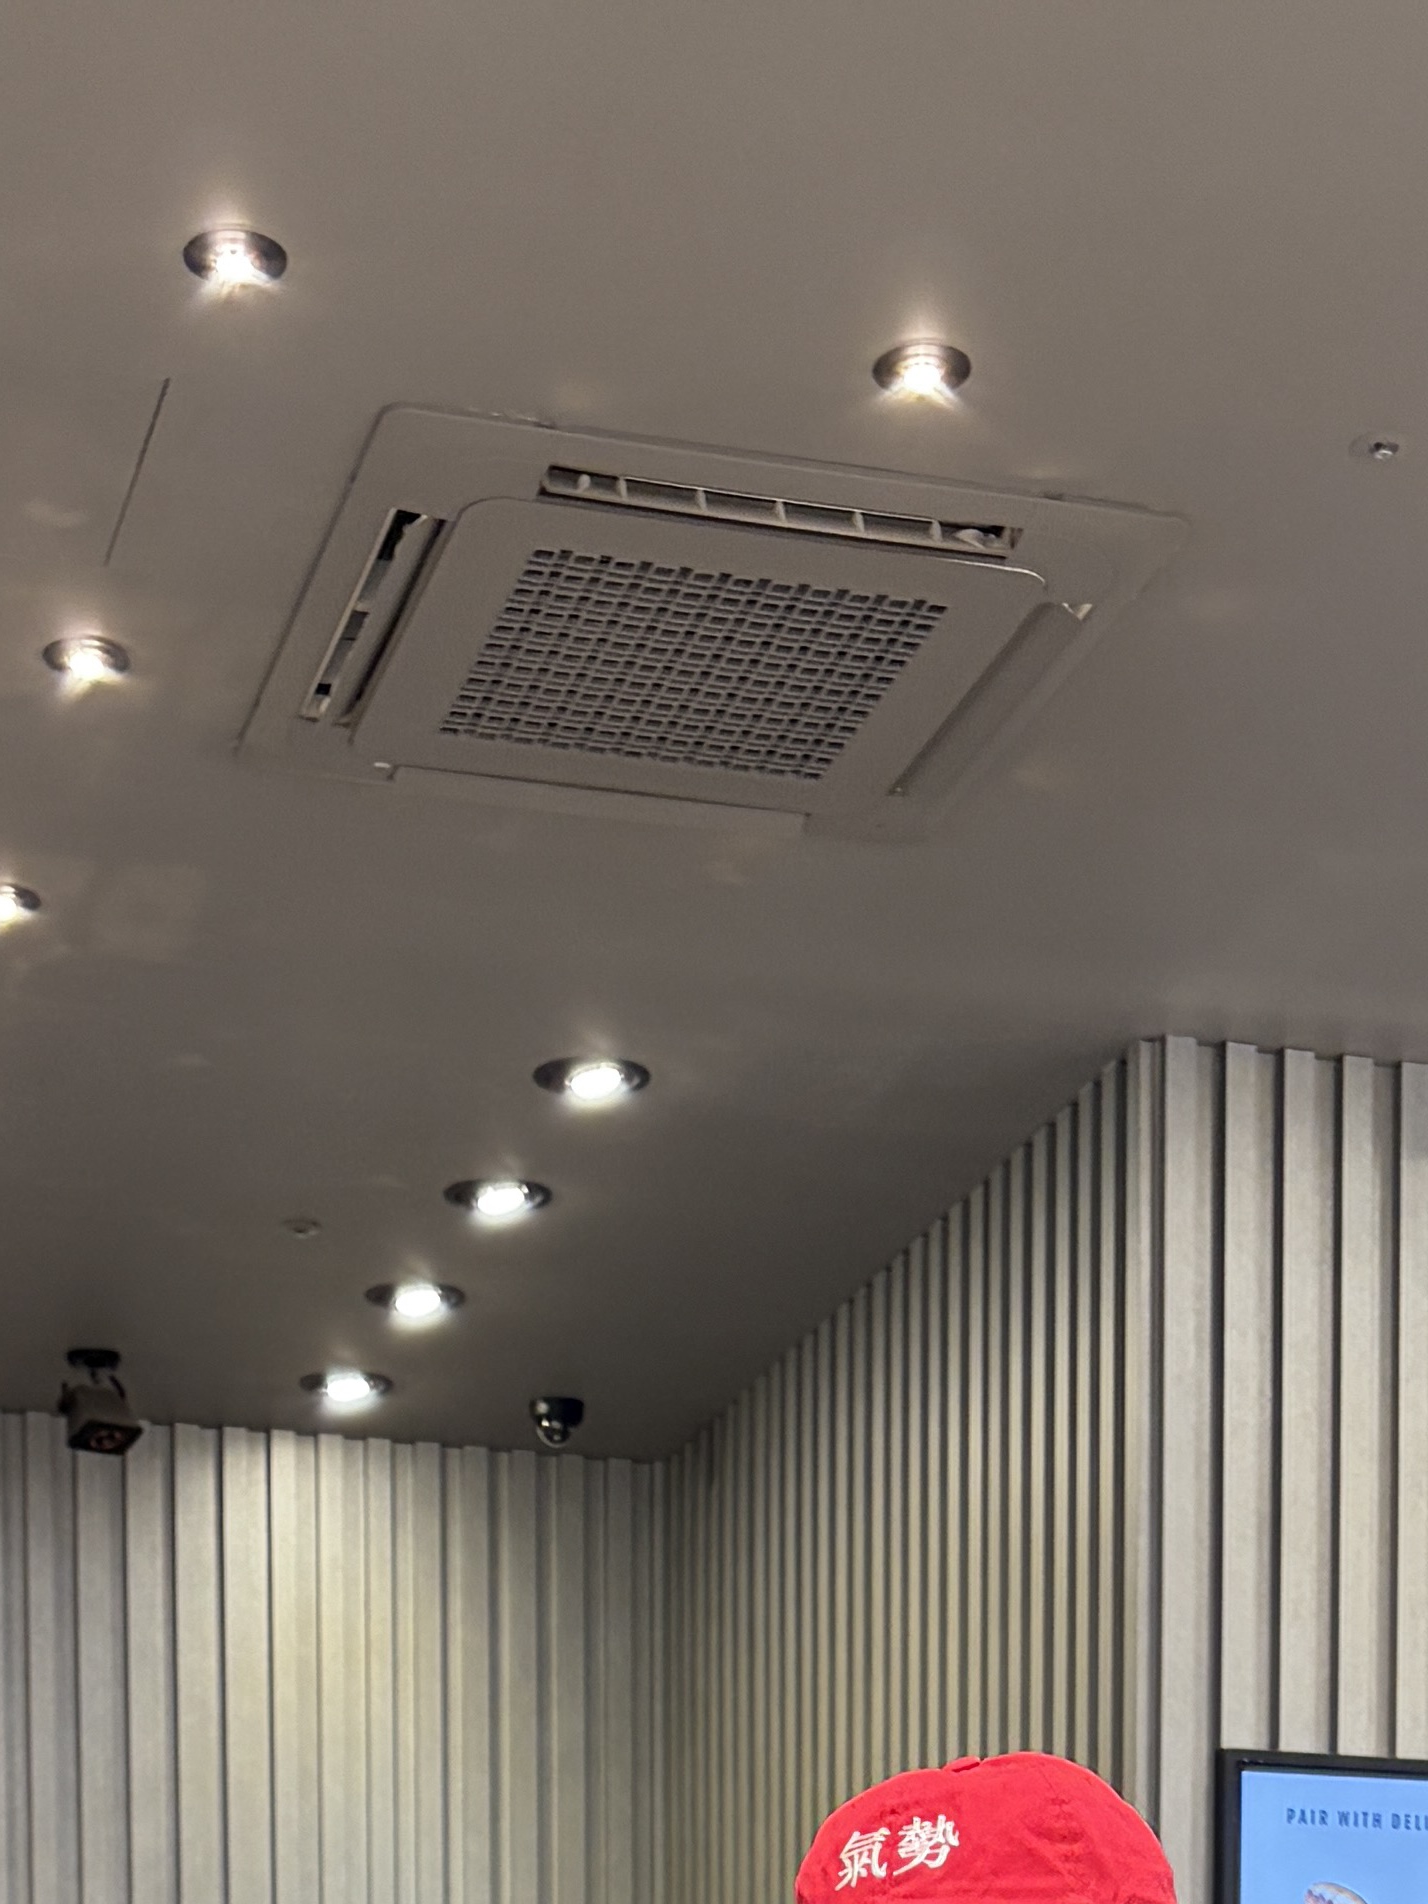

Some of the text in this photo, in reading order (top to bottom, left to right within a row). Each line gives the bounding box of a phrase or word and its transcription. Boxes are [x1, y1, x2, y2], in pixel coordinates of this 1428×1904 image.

[1286, 1808, 1328, 1826] PAIR
[1338, 1810, 1382, 1829] WITH
[835, 1814, 960, 1891] 氣勢
